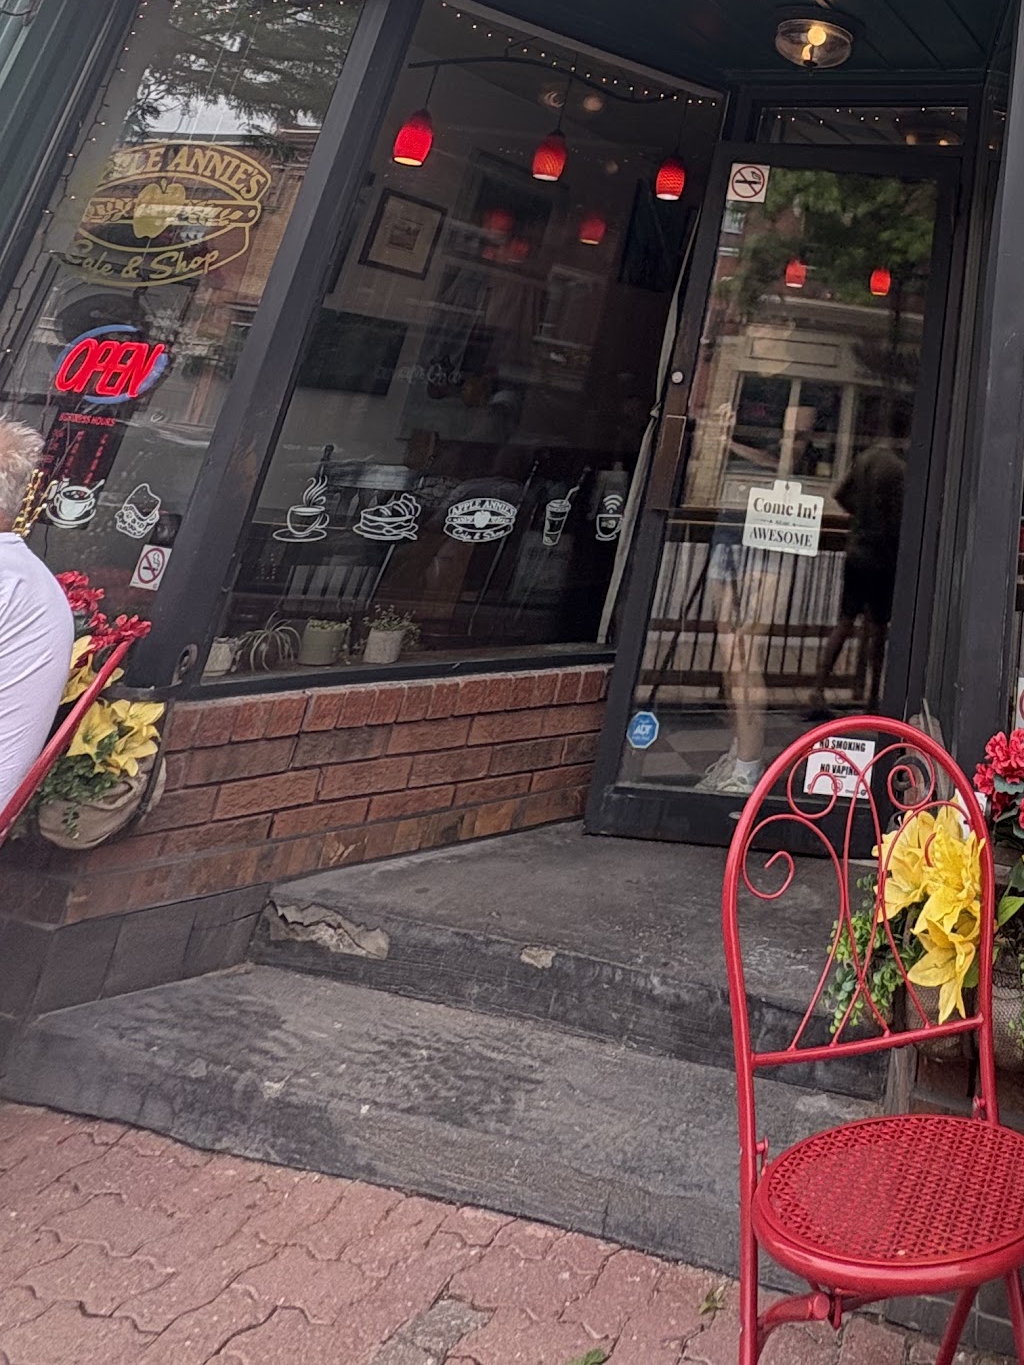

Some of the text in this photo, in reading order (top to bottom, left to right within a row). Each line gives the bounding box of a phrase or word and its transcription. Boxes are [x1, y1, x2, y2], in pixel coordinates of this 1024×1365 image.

[167, 146, 267, 200] ANNIE'S
[120, 255, 144, 278] &
[151, 249, 219, 280] Shop
[55, 337, 165, 398] OPEN
[753, 497, 818, 521] Come In!
[749, 526, 814, 548] AWESOME
[819, 738, 866, 753] NO SMOKING
[820, 763, 831, 773] NO
